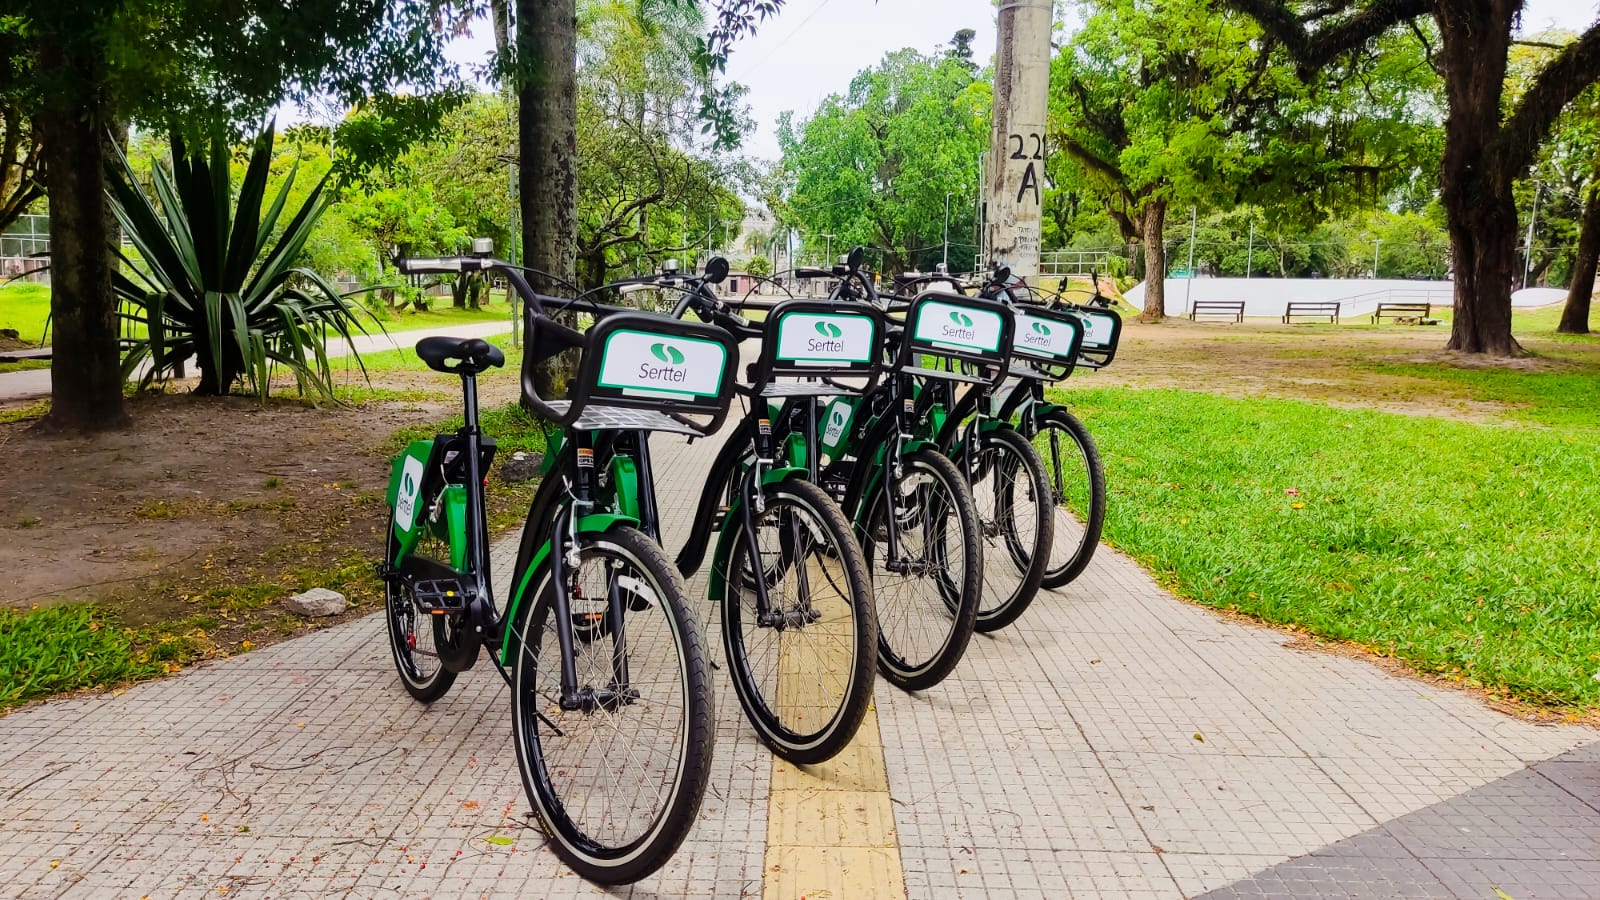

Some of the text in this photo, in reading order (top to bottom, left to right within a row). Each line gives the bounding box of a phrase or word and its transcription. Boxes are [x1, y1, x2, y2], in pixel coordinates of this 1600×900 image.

[1017, 161, 1039, 205] A
[942, 324, 975, 341] Serttel
[1023, 332, 1052, 347] Serttel
[807, 338, 844, 352] Serttel
[638, 362, 687, 383] Serttel
[825, 423, 841, 438] Serttel
[397, 491, 413, 516] Serttel
